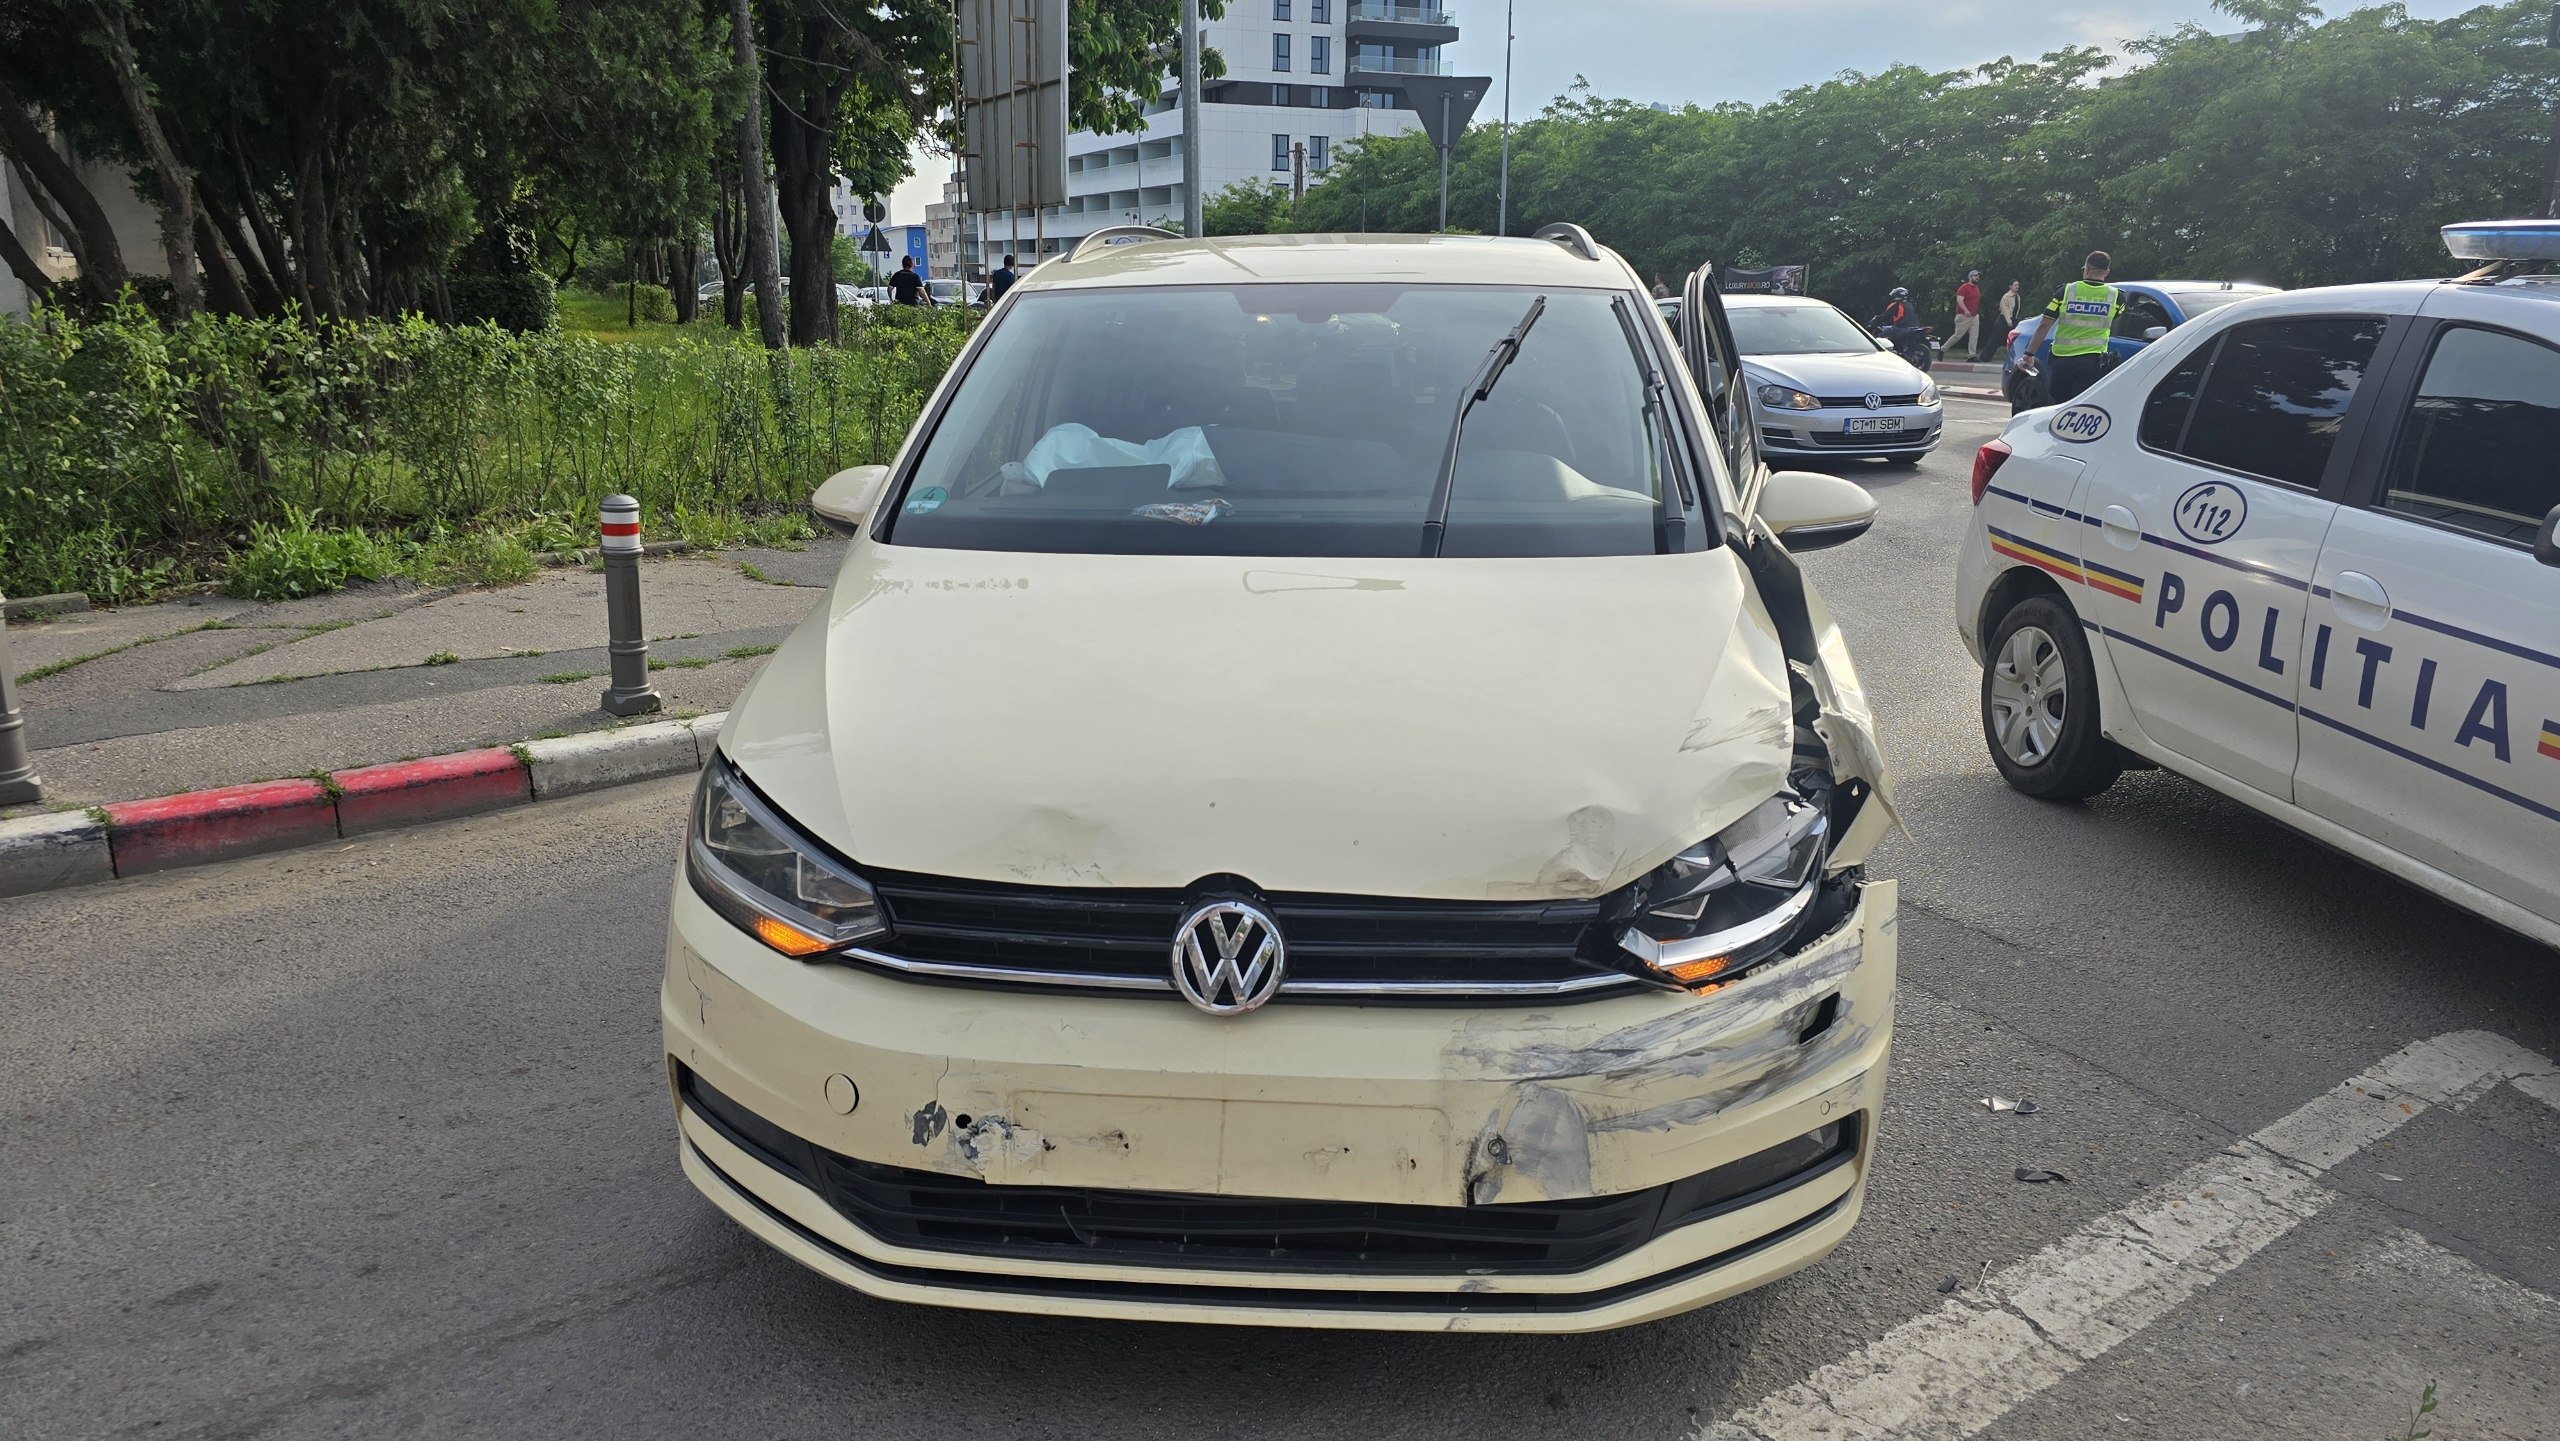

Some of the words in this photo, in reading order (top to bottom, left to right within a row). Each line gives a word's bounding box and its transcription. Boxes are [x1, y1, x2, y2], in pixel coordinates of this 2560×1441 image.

[2067, 303, 2108, 314] POLITIA
[1852, 420, 1866, 430] CT
[1869, 420, 1876, 430] 11
[1880, 419, 1901, 430] SBM
[2056, 411, 2103, 436] CT-098
[922, 487, 937, 501] 4
[2193, 503, 2231, 536] 112
[2155, 571, 2511, 764] POLITIA
[1180, 906, 1279, 1010] VW
